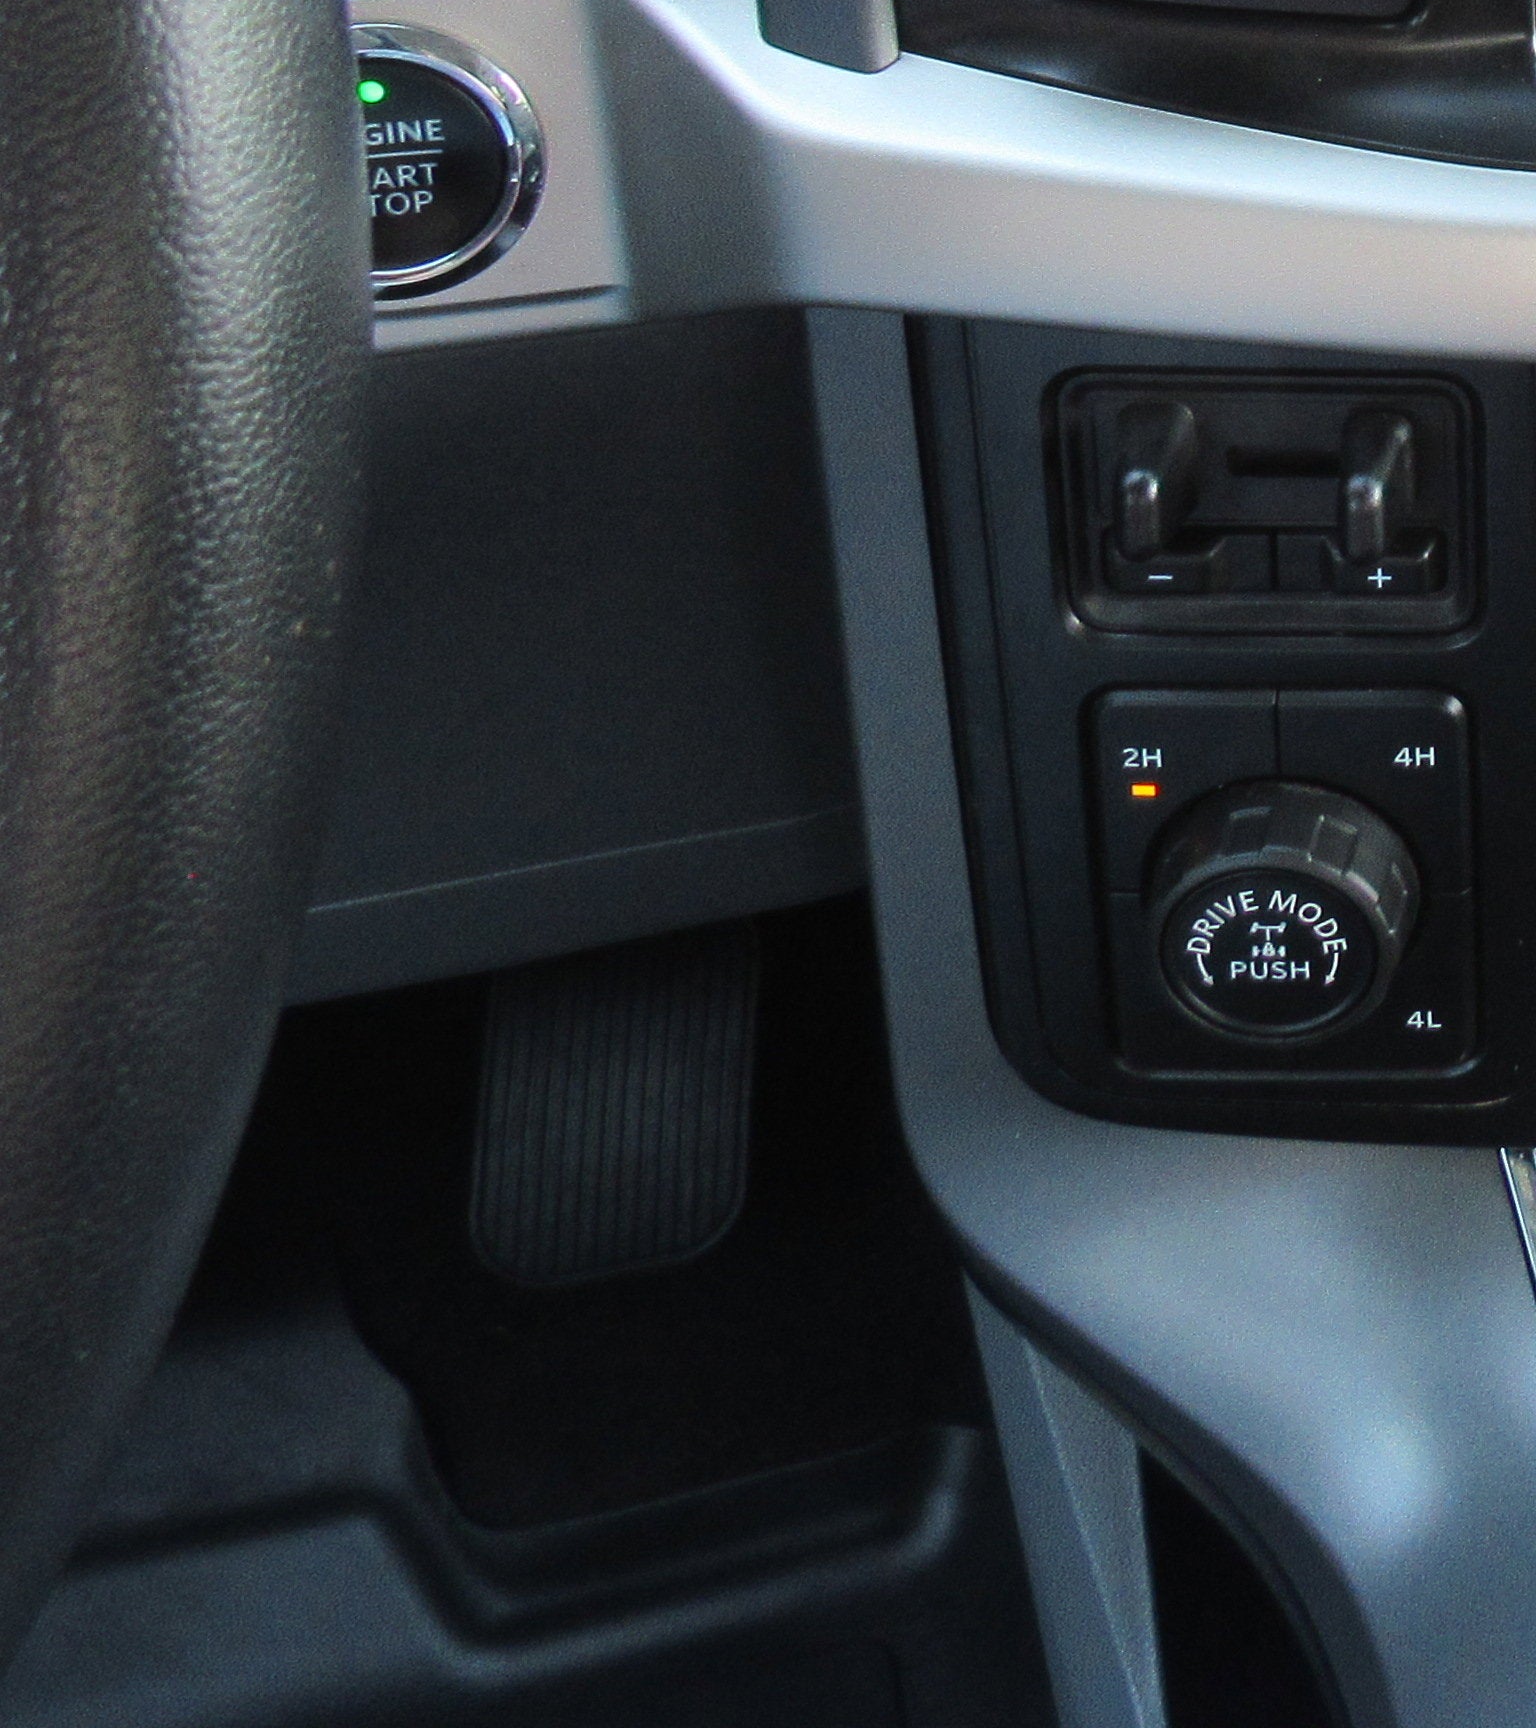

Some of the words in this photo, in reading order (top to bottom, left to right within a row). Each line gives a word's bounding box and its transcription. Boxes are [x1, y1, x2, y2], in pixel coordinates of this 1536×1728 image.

[365, 119, 445, 146] GINE
[373, 162, 437, 189] ART
[369, 190, 434, 217] TOP
[1122, 747, 1163, 769] 2H
[1394, 745, 1436, 768] 4H
[1186, 890, 1259, 954] DRIVE
[1268, 890, 1348, 954] MODE
[1230, 961, 1310, 980] PUSH
[1407, 1009, 1442, 1030] 4L
